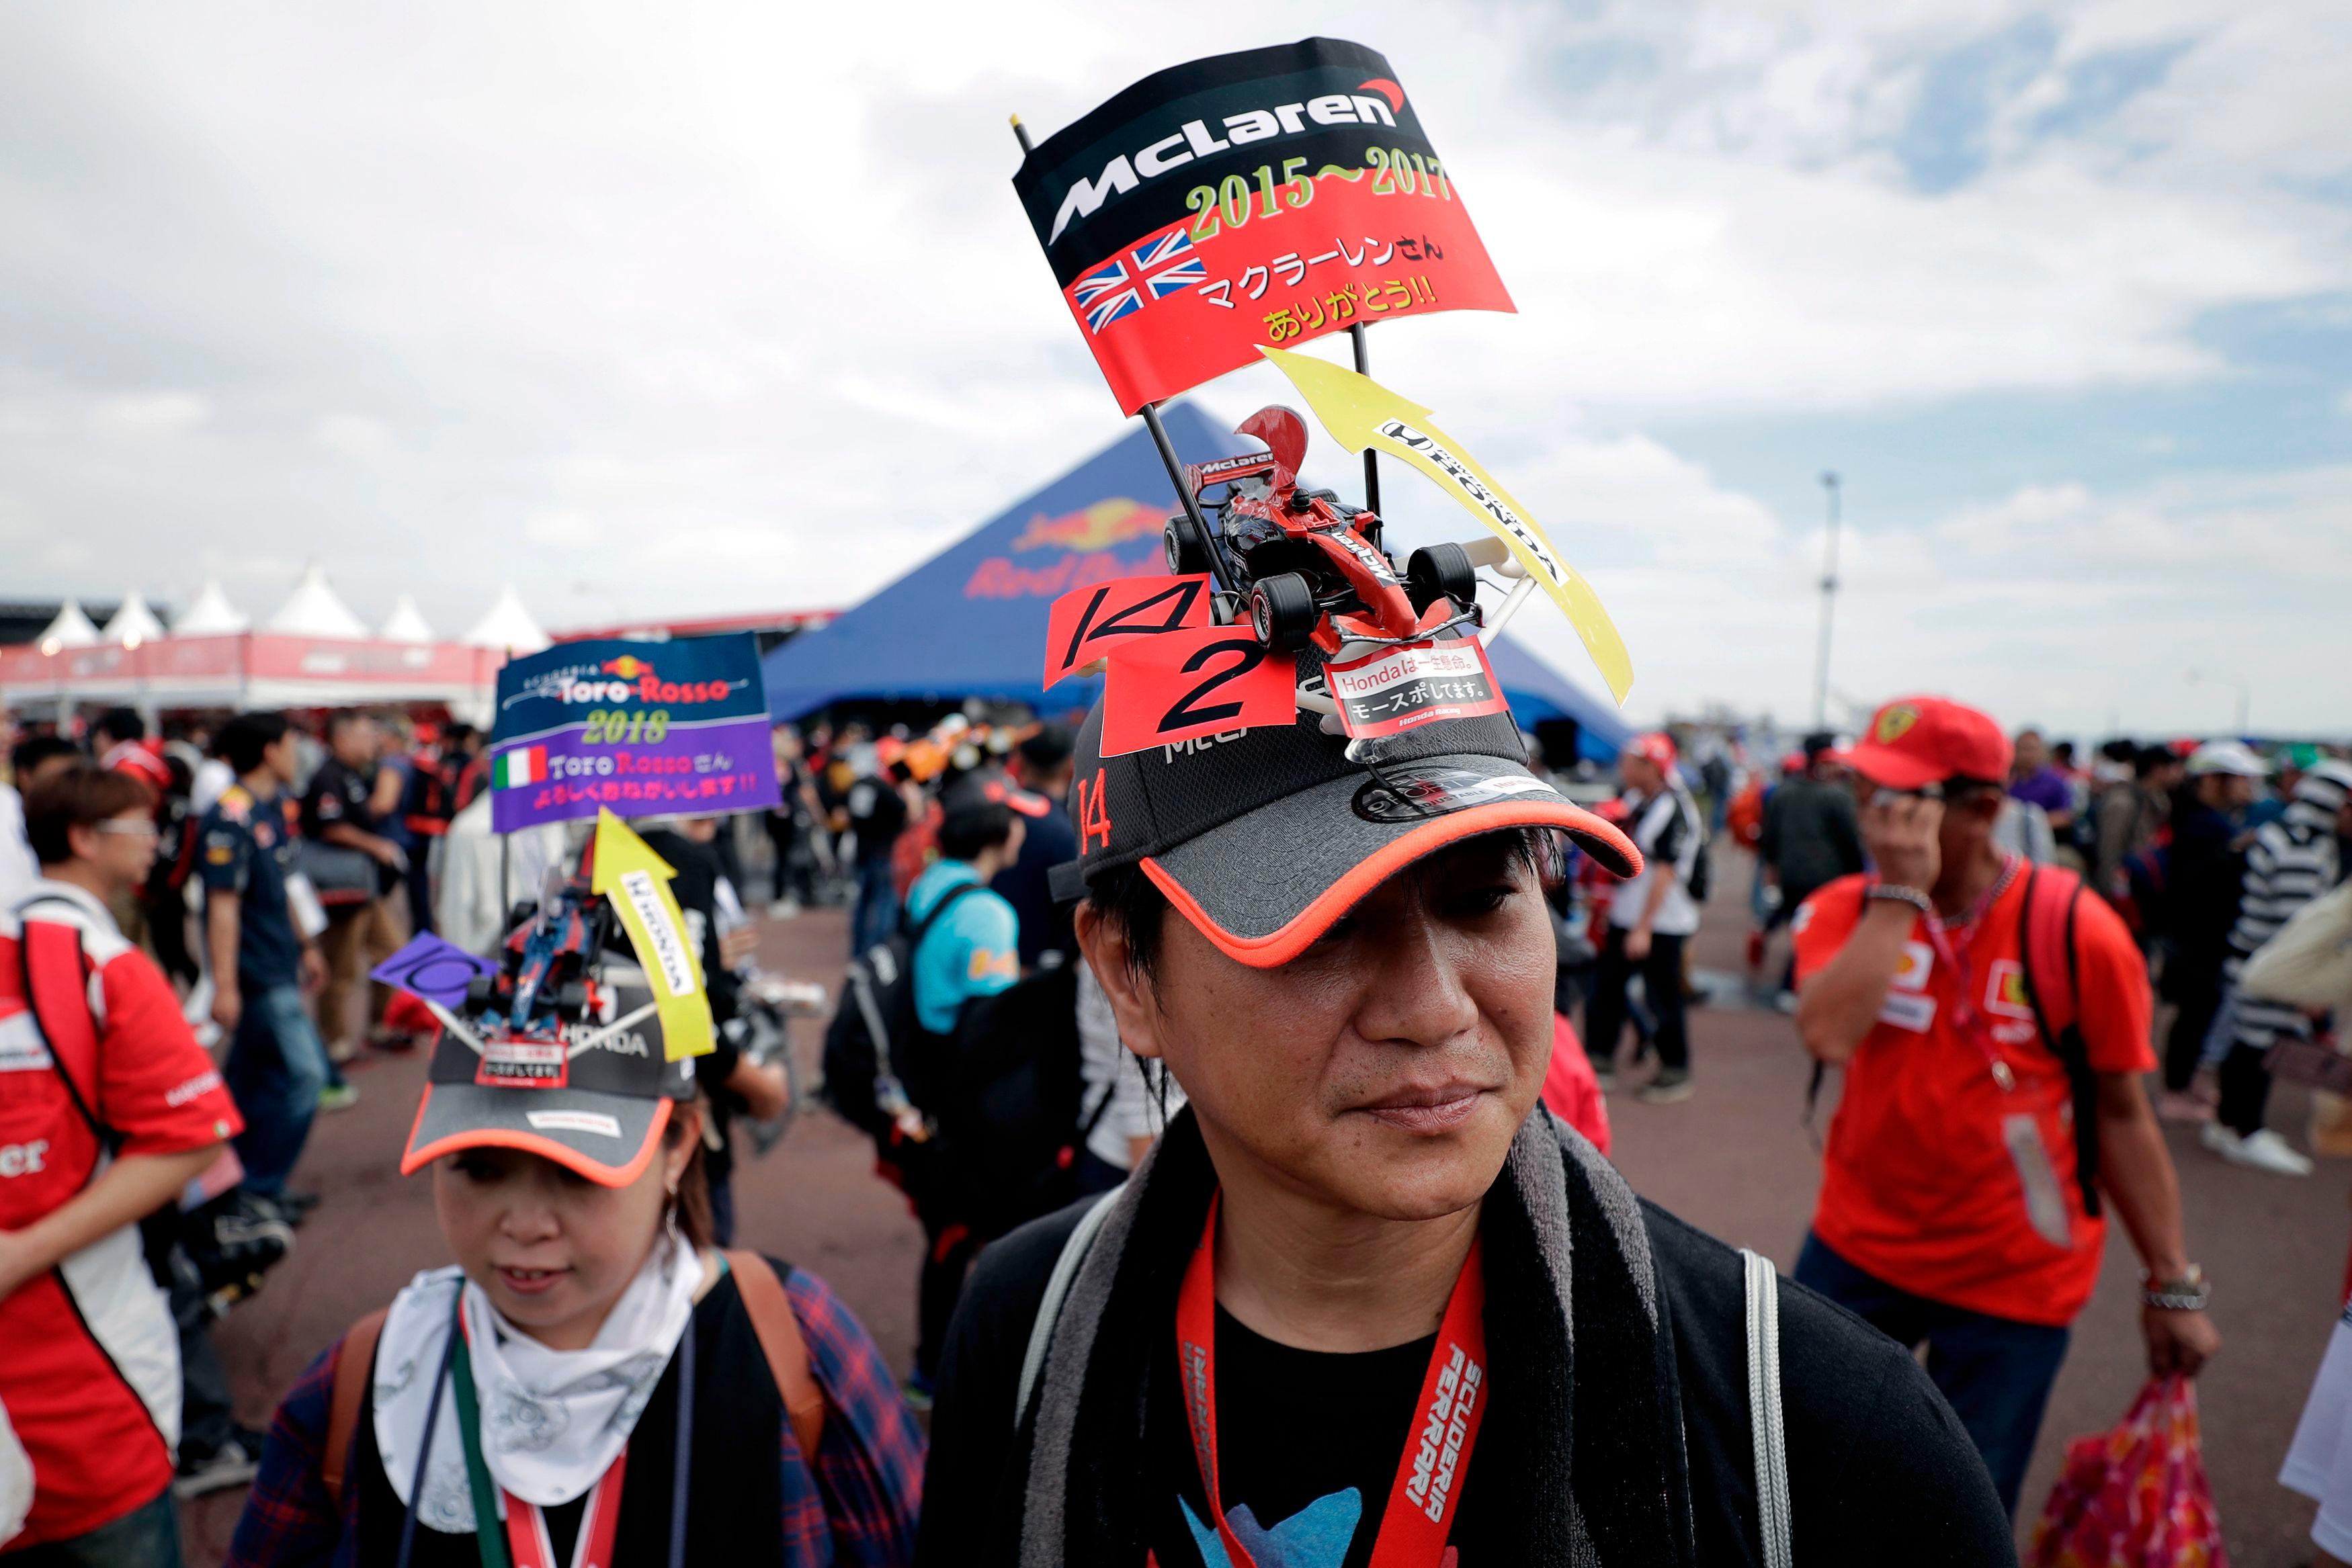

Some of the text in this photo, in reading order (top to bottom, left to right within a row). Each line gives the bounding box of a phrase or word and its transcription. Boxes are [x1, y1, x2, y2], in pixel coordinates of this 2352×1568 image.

[1047, 93, 1397, 247] McLaren
[1198, 233, 1444, 309] マクラーレンさん
[1426, 451, 1560, 584] HONDA
[1060, 580, 1204, 671] 14
[581, 709, 671, 745] 2018
[639, 674, 730, 704] Rosso
[1155, 638, 1266, 734] 2
[1351, 681, 1484, 720] モースポしてます。
[1398, 710, 1434, 727] Honda
[1077, 768, 1112, 855] 14
[382, 945, 483, 996] 10
[1405, 1342, 1466, 1508] FERRARI
[1425, 1358, 1482, 1524] SCUDERIA
